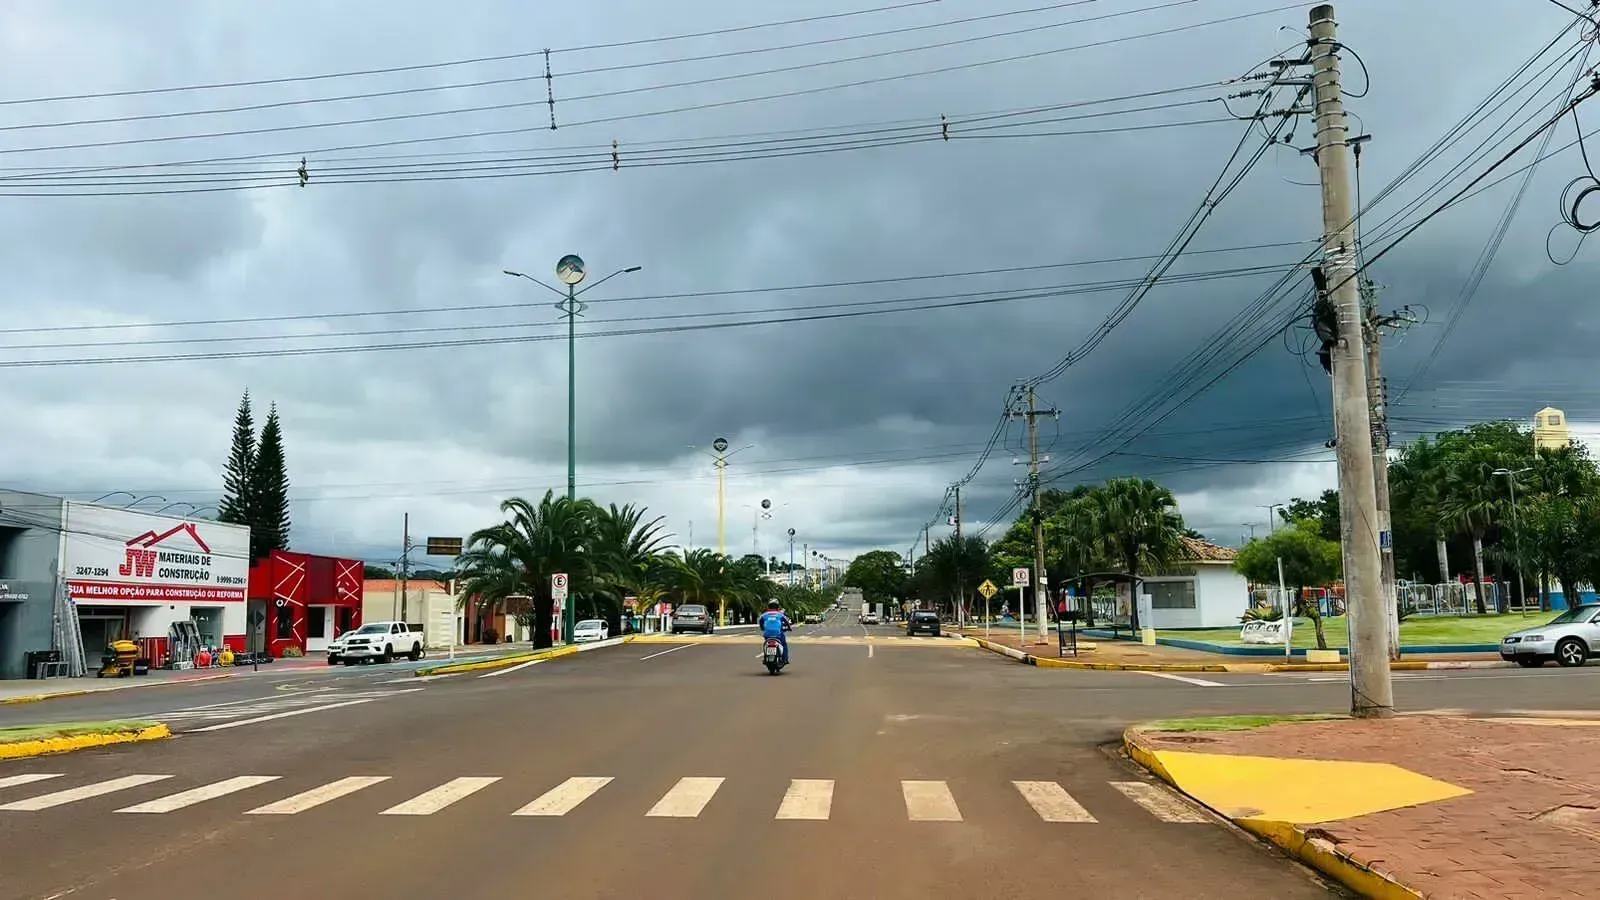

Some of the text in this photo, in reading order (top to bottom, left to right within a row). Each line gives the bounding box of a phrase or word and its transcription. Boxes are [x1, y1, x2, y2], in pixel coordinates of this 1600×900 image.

[119, 549, 157, 577] JW
[159, 552, 211, 566] MATERIAIS DE
[159, 568, 210, 582] CONSTRUÇÃO
[86, 585, 118, 596] MELHOR
[120, 587, 145, 598] OPÇÃO
[165, 589, 206, 599] CONSTRUÇÃO
